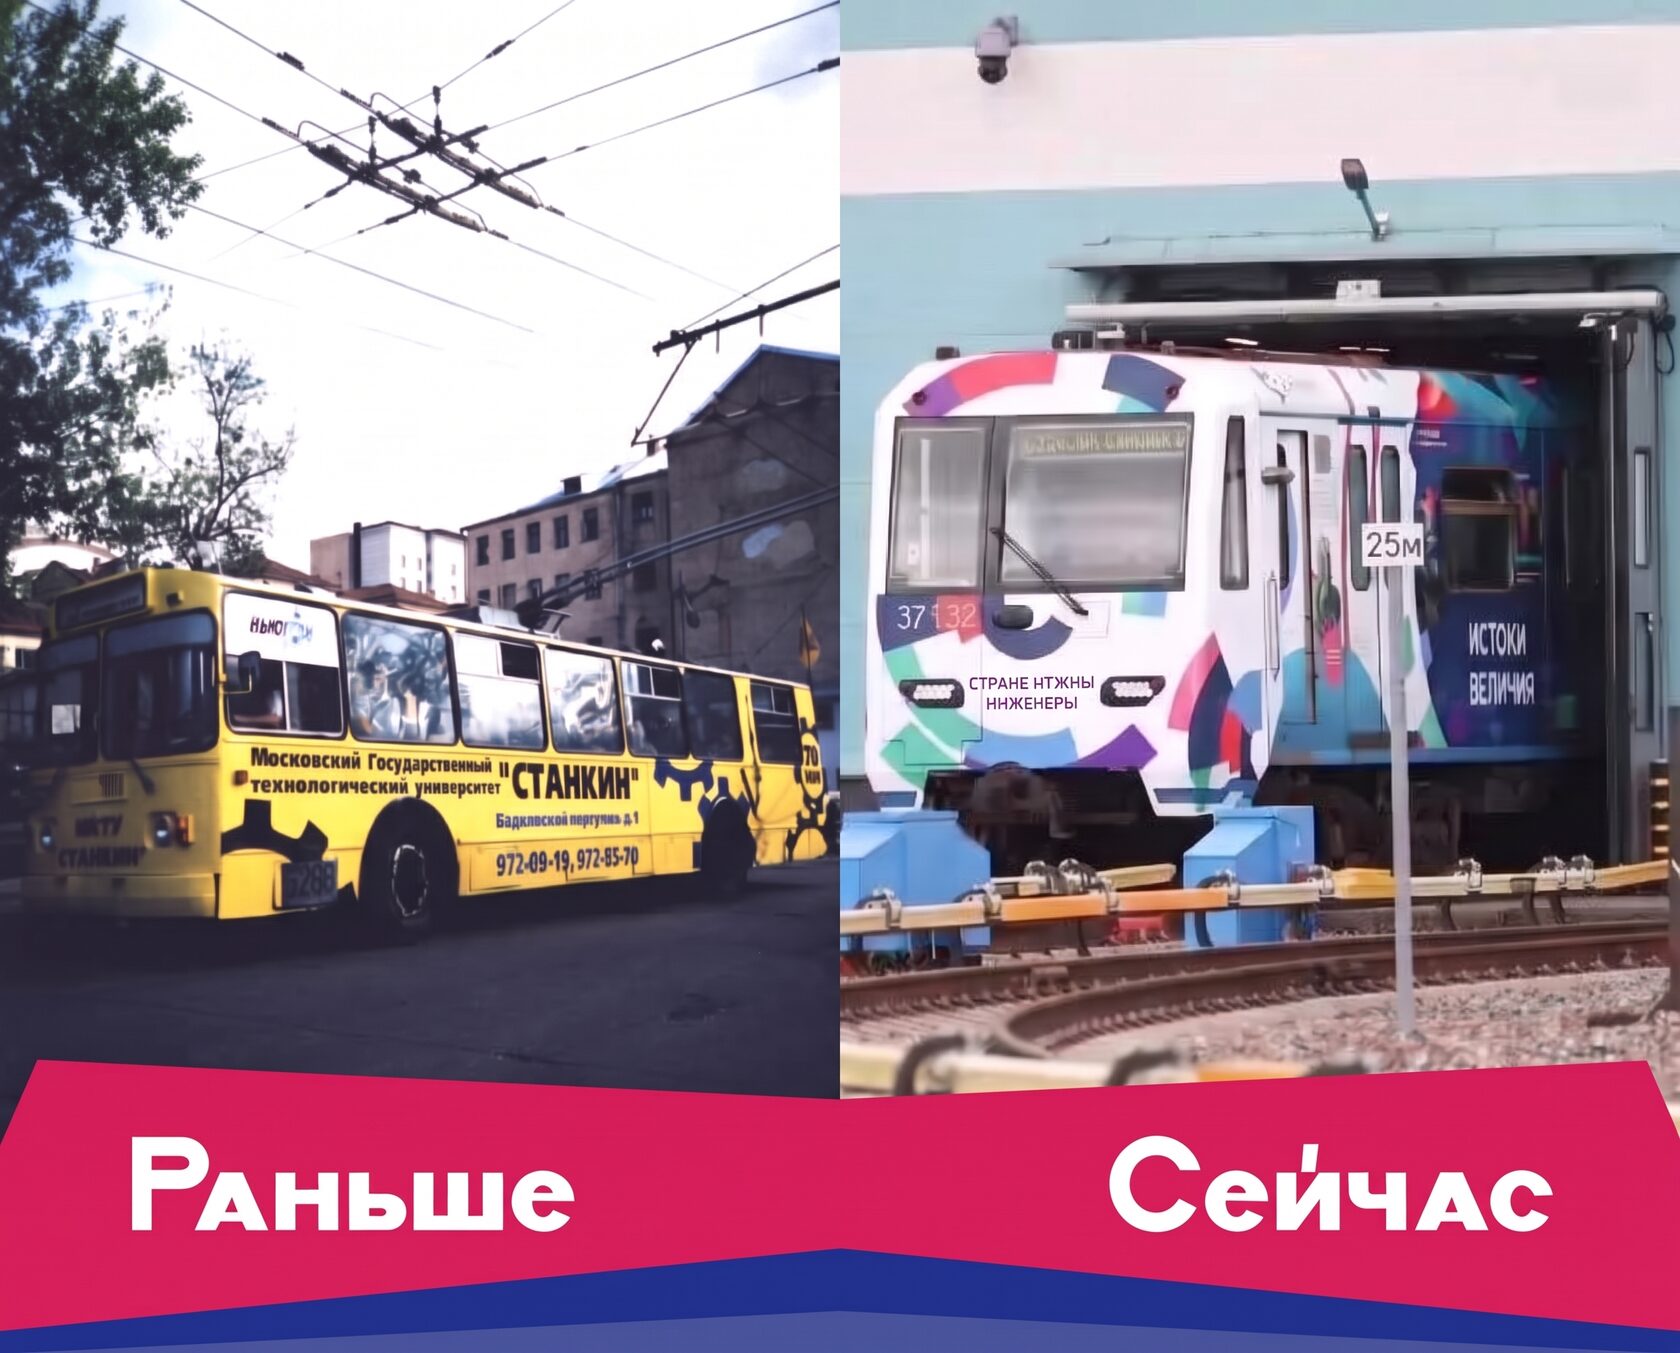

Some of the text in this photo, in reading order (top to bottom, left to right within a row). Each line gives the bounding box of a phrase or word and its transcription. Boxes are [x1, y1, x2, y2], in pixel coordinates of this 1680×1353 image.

[1468, 622, 1526, 656] ИСТОКИ
[969, 676, 1029, 690] СТРАНЕ
[1469, 671, 1535, 706] ВЕЛИЧИЯ
[250, 747, 492, 776] Московский Государственный
[803, 744, 819, 767] 70
[250, 777, 502, 799] технологический университет
[499, 761, 639, 800] "СТАНКИН"
[496, 846, 639, 877] 972-09-19, 972-85-70
